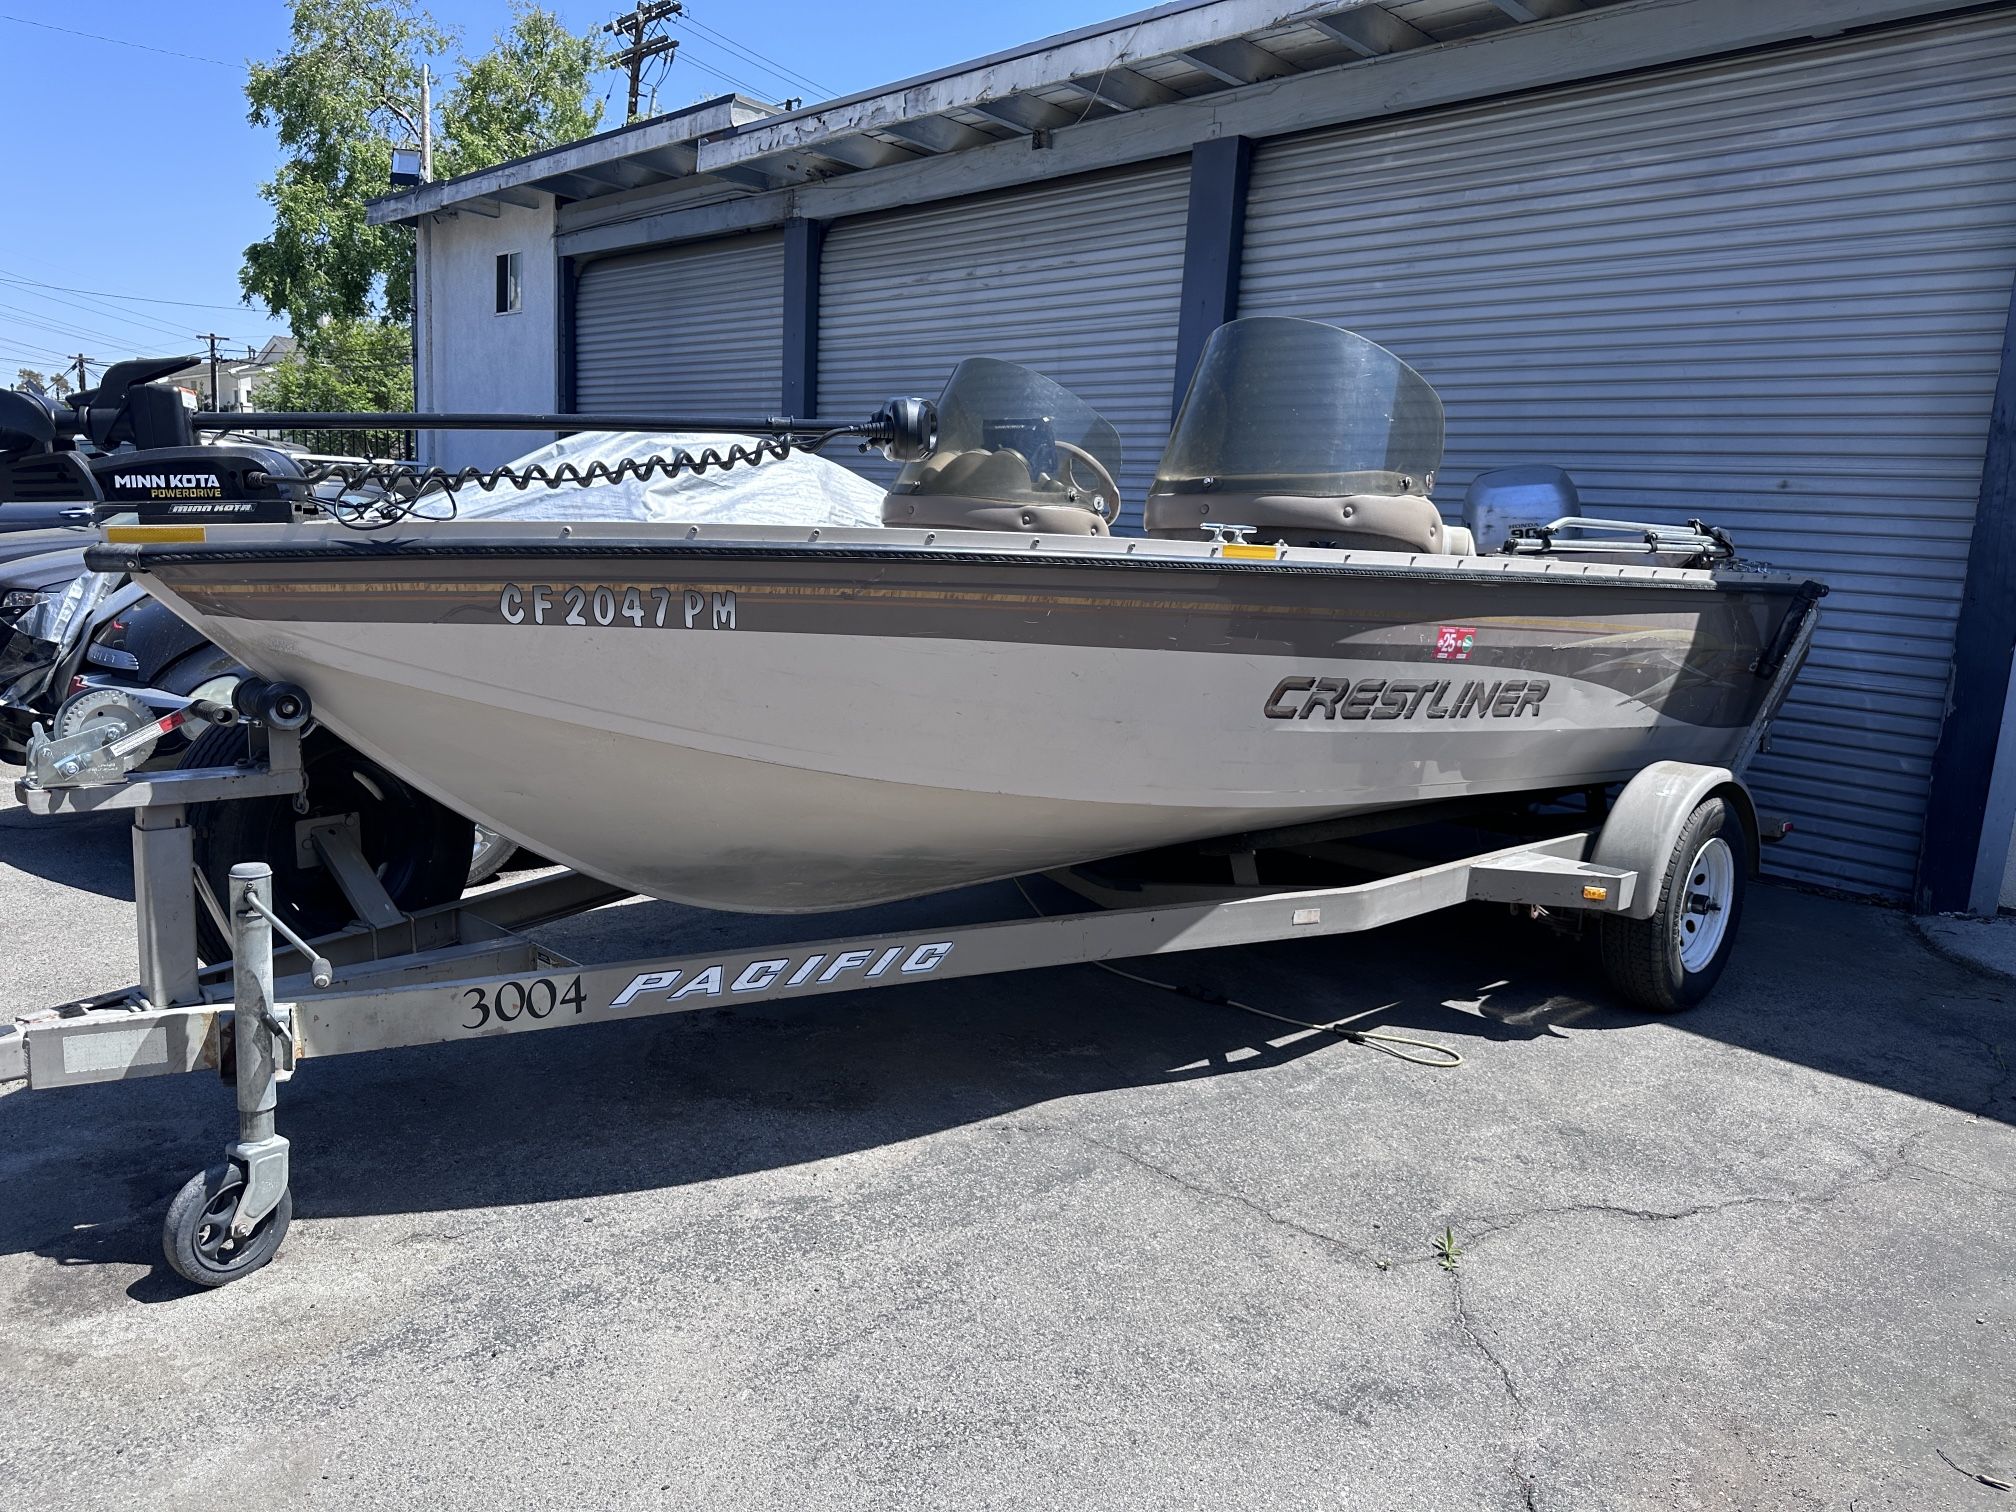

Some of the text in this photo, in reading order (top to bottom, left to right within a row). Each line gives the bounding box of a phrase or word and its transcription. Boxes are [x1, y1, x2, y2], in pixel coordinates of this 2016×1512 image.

[114, 474, 220, 488] MINN KOTA
[151, 488, 222, 498] POWERDRIVE
[500, 583, 737, 630] CF 2047 PM
[1441, 633, 1456, 652] 25
[1264, 675, 1550, 720] CRESTLINER
[608, 940, 954, 1009] PACIFIC
[462, 975, 587, 1030] 3004
